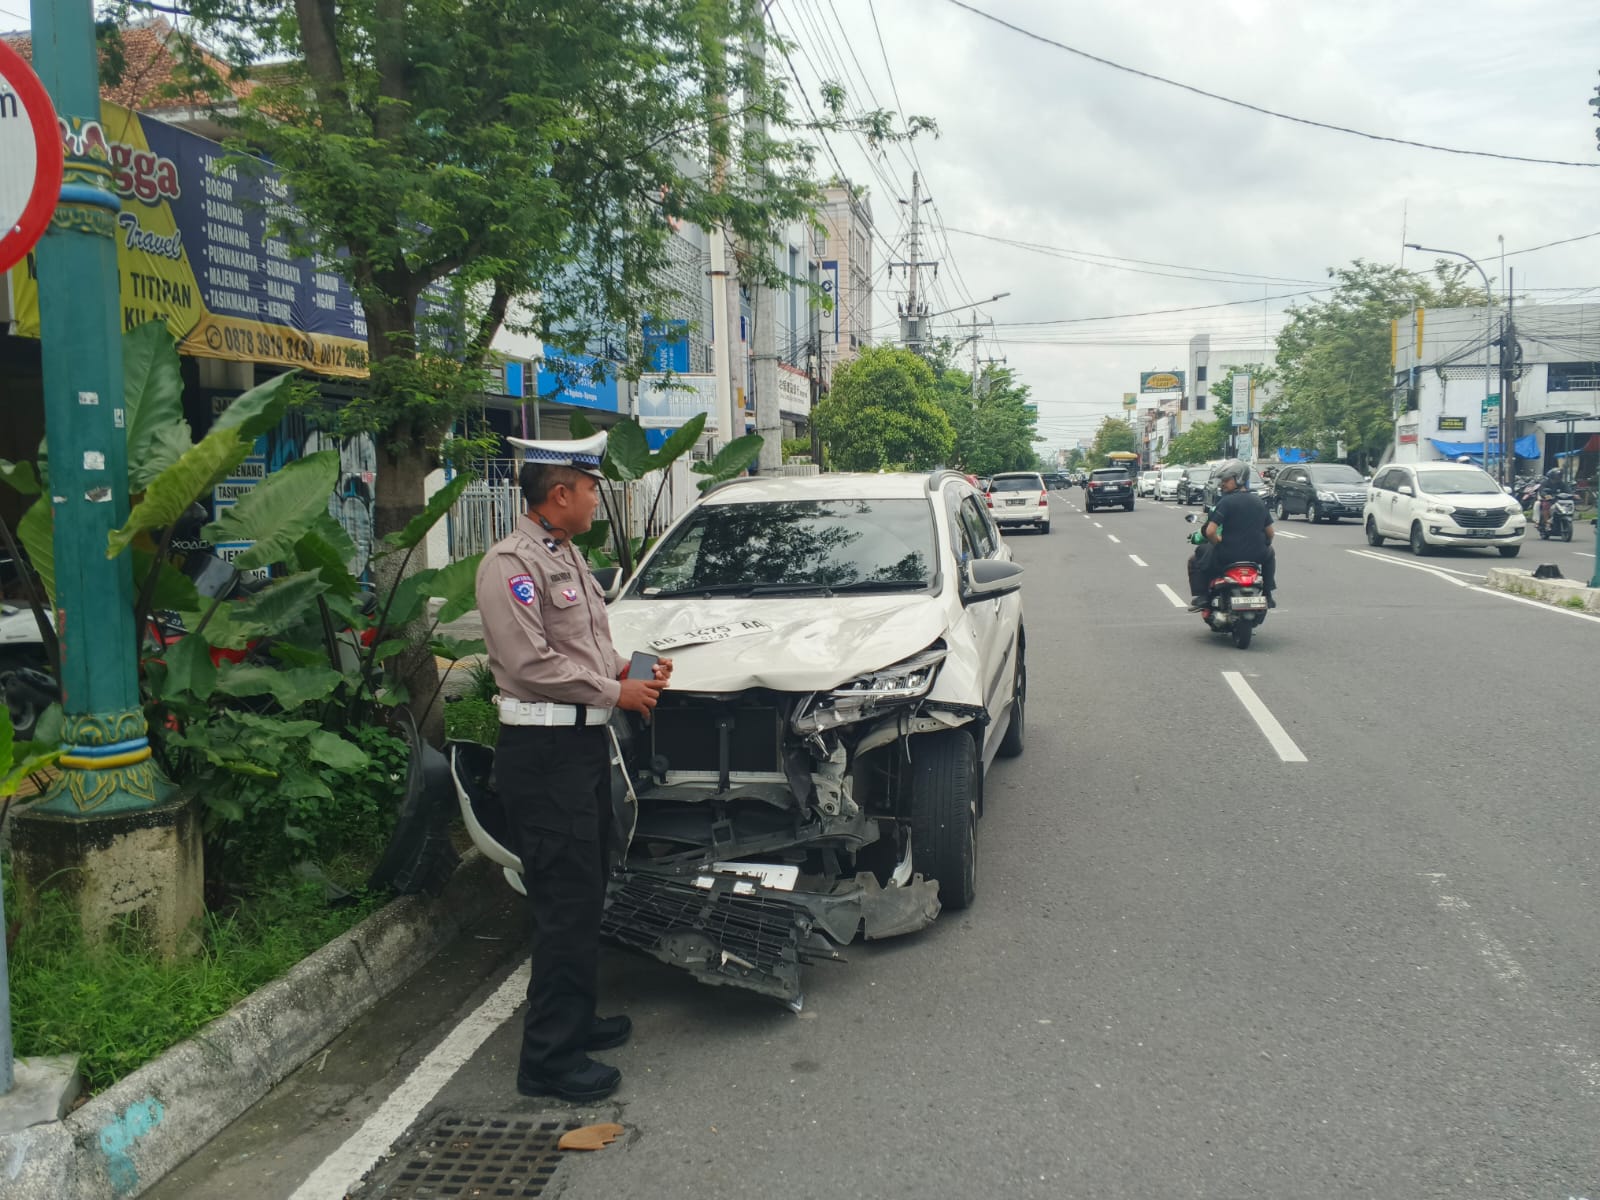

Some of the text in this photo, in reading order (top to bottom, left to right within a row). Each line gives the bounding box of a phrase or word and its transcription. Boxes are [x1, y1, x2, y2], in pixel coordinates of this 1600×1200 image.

[205, 176, 233, 202] BOGOR
[206, 199, 243, 227] BANDUNG
[118, 211, 182, 260] Travel
[207, 222, 250, 250] KARAWANG
[208, 244, 259, 273] PURWAKARTA
[266, 259, 302, 284] SURABAYA
[130, 271, 192, 309] TITIPAN
[209, 267, 249, 292] MAJENANG
[266, 280, 295, 302] MALANG
[209, 289, 260, 315] TASIKMALAYA
[224, 326, 254, 354] 0878
[257, 332, 283, 357] 3919
[320, 343, 342, 366] 0812
[741, 620, 765, 629] AA
